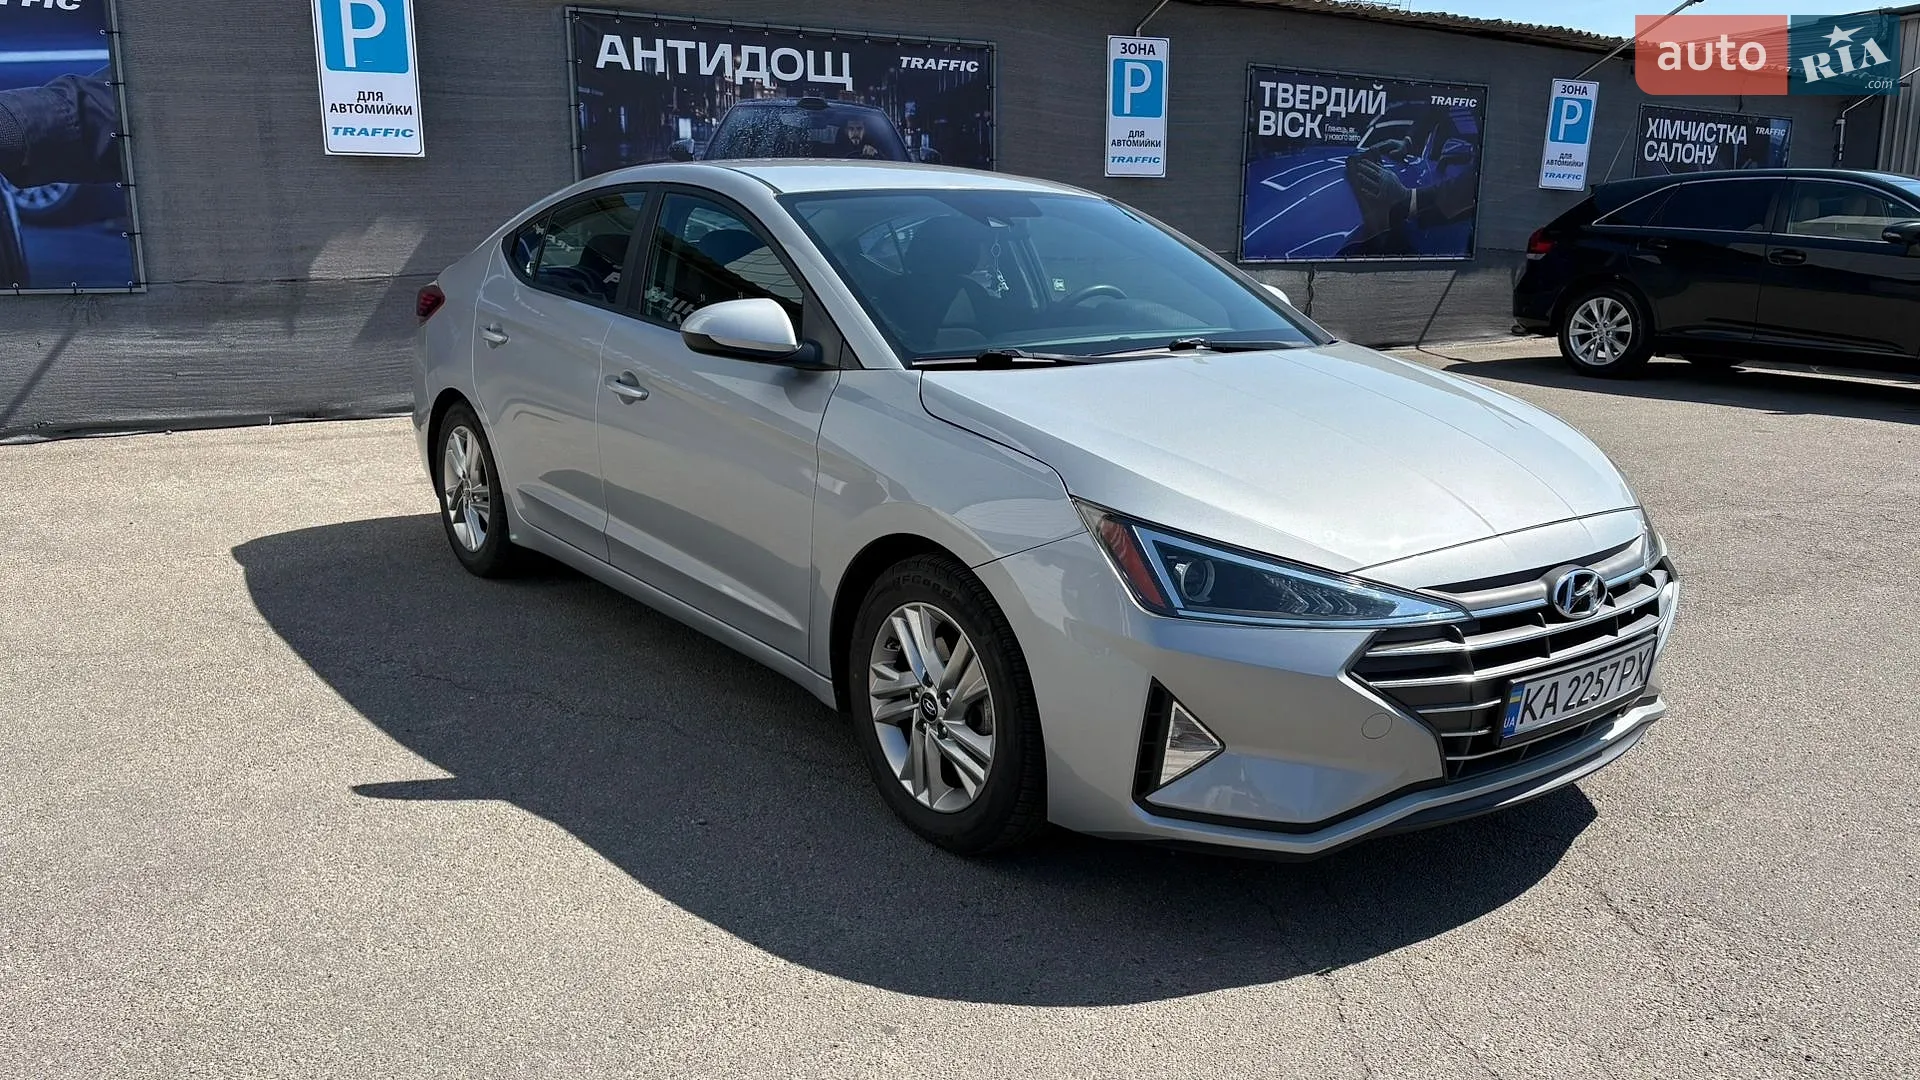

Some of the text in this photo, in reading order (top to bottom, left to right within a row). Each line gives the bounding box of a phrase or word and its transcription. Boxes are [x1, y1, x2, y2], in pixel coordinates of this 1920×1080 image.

[1120, 42, 1156, 56] ЗОНА
[595, 33, 854, 92] АНТИДОЩ
[899, 56, 980, 73] TRAFFIC
[356, 90, 384, 104] ДЛЯ
[1560, 84, 1588, 96] ЗОНА
[1259, 80, 1387, 118] ТВЕРДИЙ
[1430, 95, 1478, 108] TRAFFIC
[329, 102, 413, 116] АВТОМИЙКИ
[1258, 110, 1324, 139] ВІСК
[1645, 117, 1748, 145] ХІМЧИСТКА
[1755, 126, 1786, 137] TRAFFIC
[331, 126, 415, 138] TRAFFIC
[1127, 130, 1145, 138] ДЛЯ
[1110, 138, 1162, 148] АВТОМИЙКИ
[1110, 155, 1161, 164] TRAFFIC
[1644, 140, 1719, 165] САЛОНУ
[1544, 172, 1583, 181] TRAFFIC
[1519, 680, 1560, 725] KA
[1561, 660, 1621, 713] 2257
[1503, 715, 1516, 729] UA
